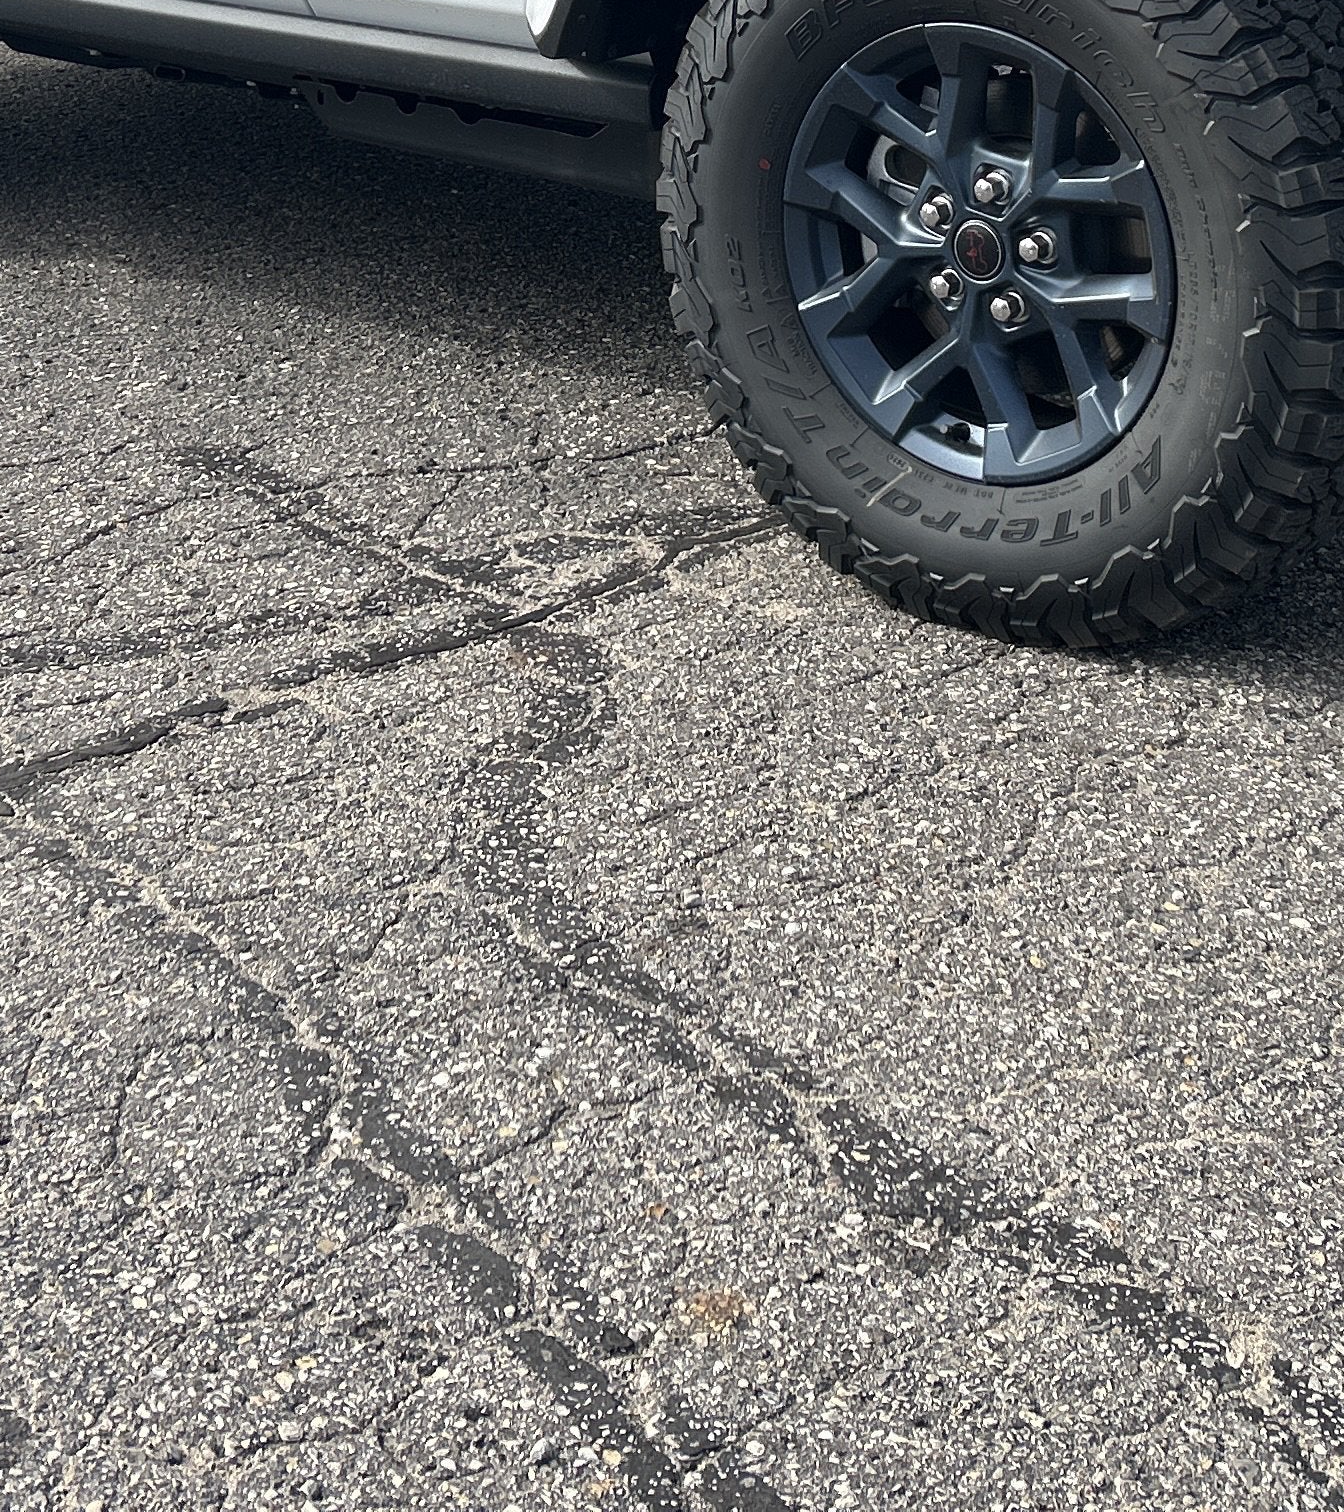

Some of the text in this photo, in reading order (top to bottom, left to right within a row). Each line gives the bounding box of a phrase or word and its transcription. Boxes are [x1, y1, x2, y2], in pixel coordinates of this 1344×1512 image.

[725, 237, 1163, 548] All-Terrain T/A KO2
